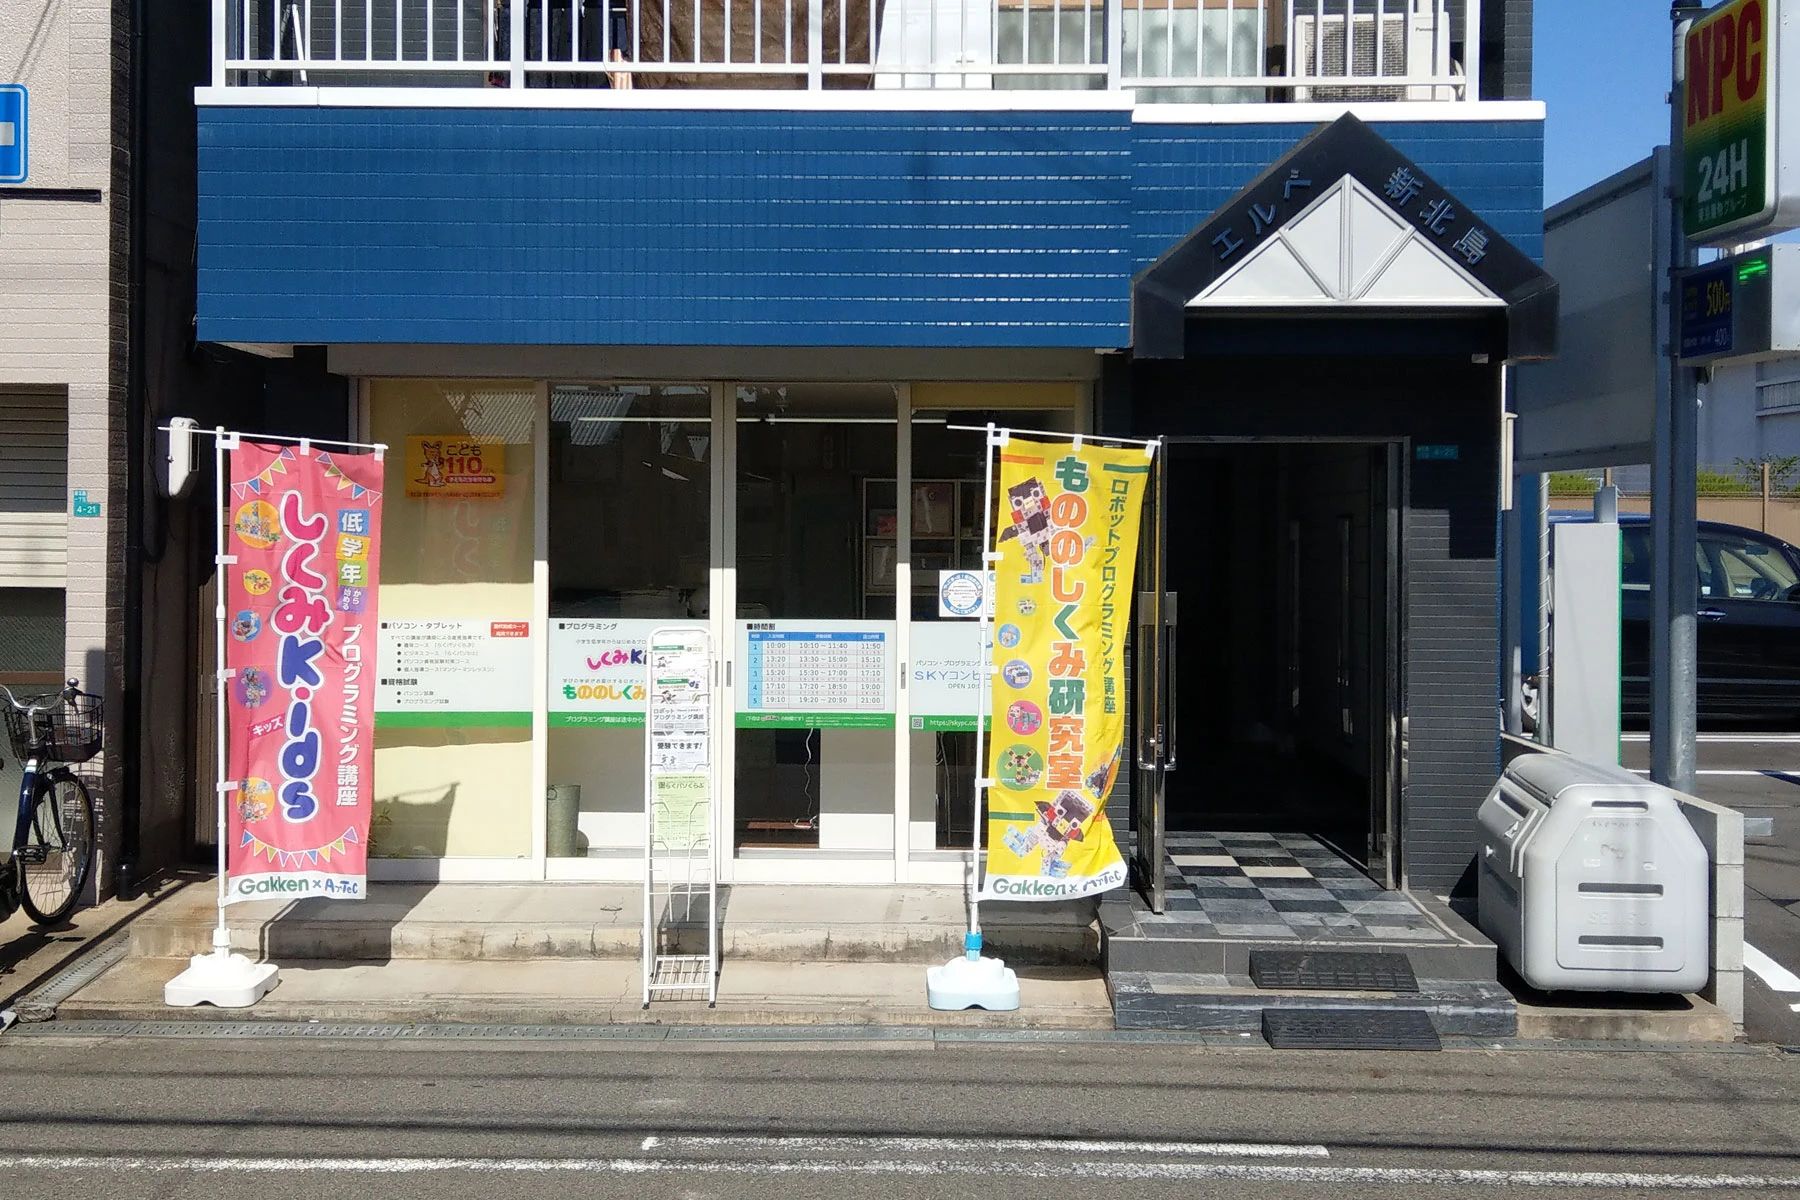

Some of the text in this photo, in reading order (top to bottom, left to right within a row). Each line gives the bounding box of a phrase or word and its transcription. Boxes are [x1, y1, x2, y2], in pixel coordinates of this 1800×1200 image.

[1687, 1, 1761, 127] NPC
[1698, 138, 1748, 203] 24H
[1384, 166, 1490, 265] 新北島
[446, 444, 482, 456] こども
[77, 506, 97, 514] 4-21
[341, 512, 364, 583] 低学年
[1101, 479, 1129, 714] ロボットプログラミング講座
[753, 623, 775, 631] 時間割
[1047, 455, 1090, 790] もののしくみ研究室
[388, 678, 418, 686] 資格試験
[252, 716, 284, 736] キッズ
[335, 625, 363, 806] プログラミング講座
[238, 876, 309, 895] Gakken
[992, 878, 1067, 896] Gakken
